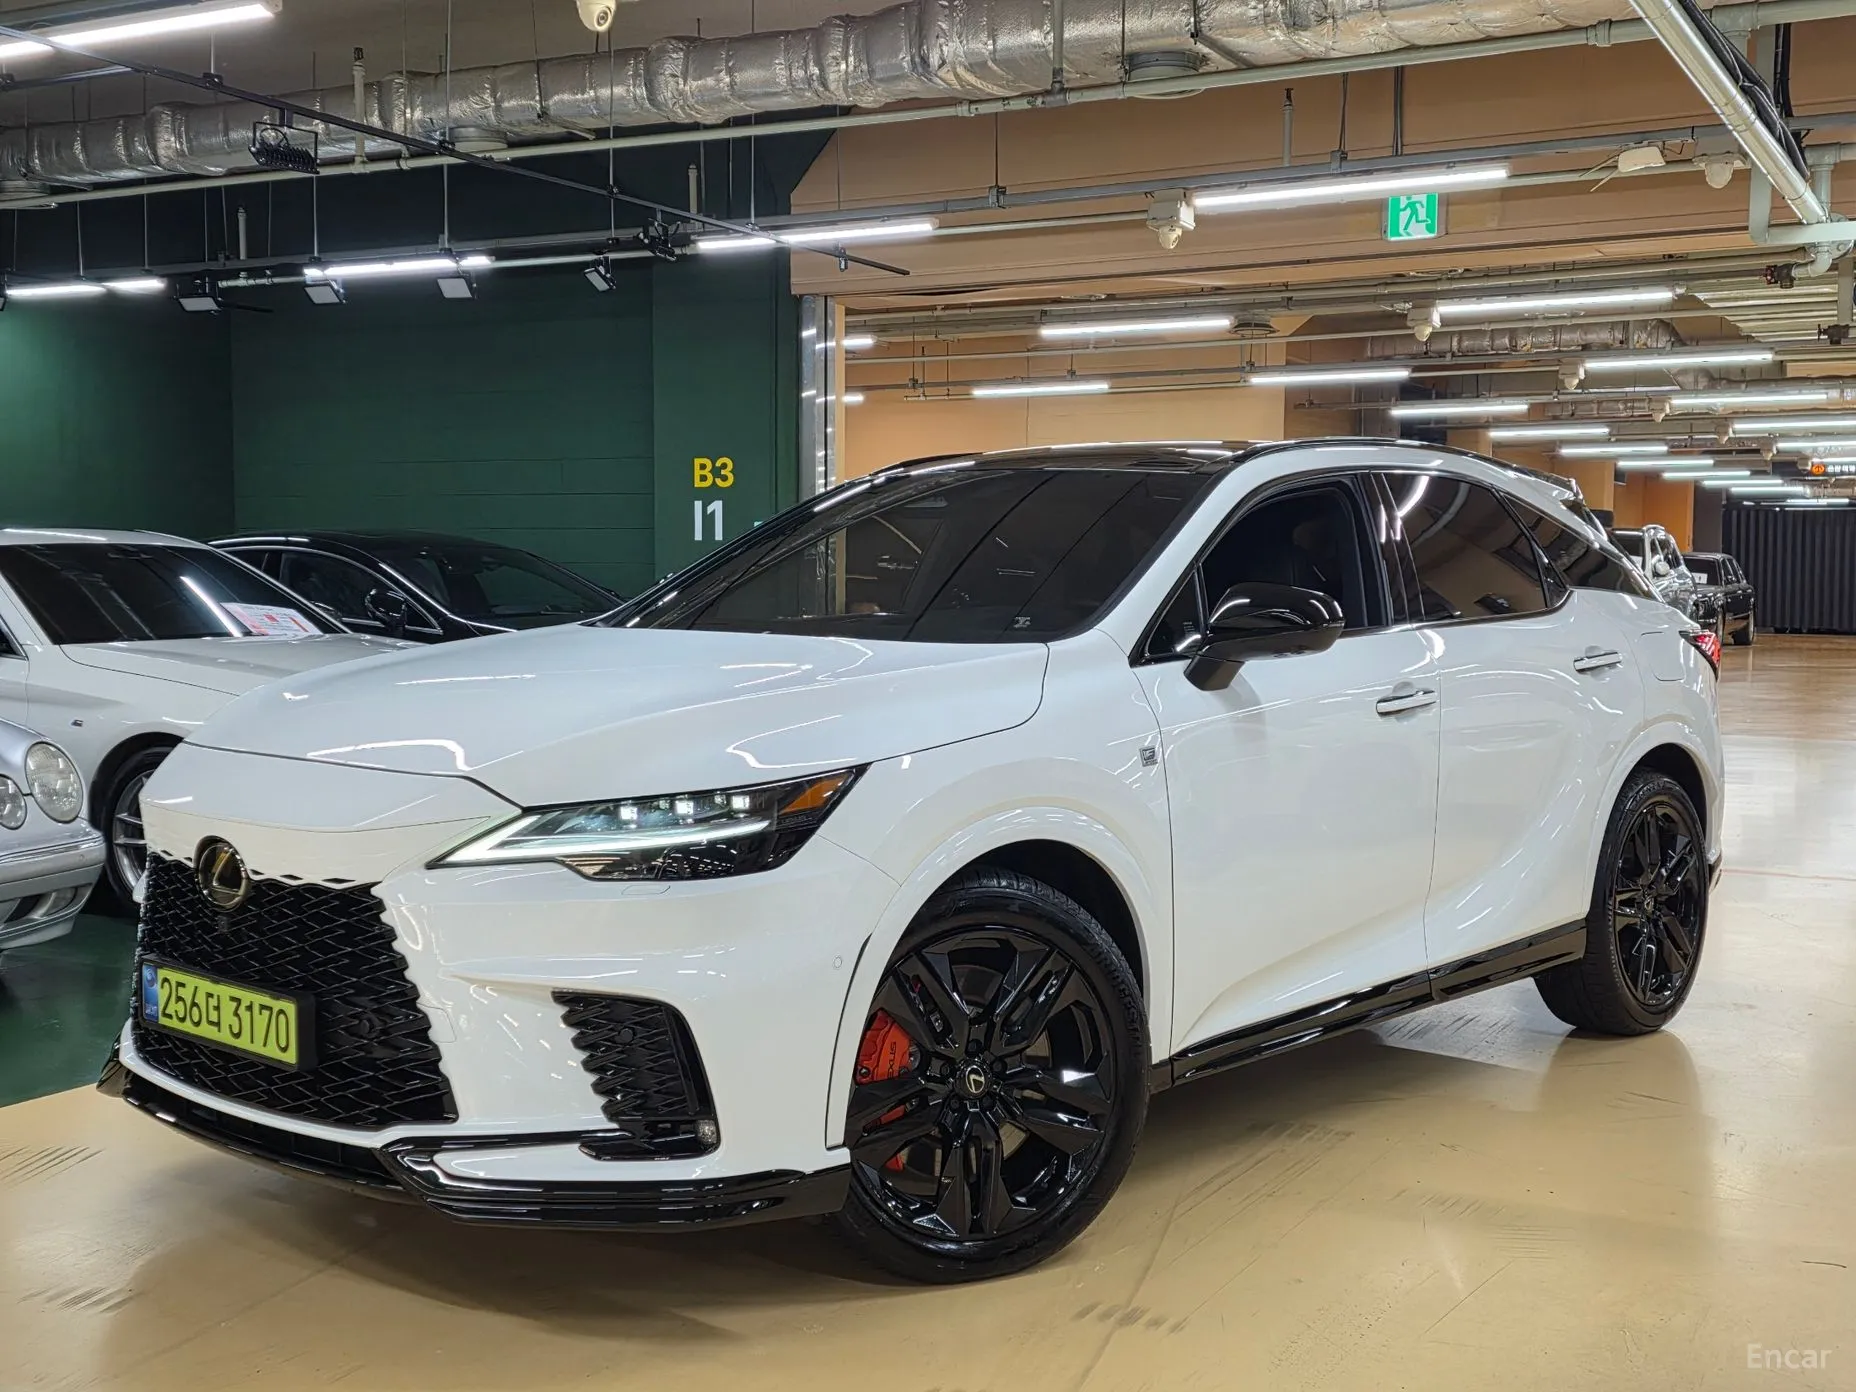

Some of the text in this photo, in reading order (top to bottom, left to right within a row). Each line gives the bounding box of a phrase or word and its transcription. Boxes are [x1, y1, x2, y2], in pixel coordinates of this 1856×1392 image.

[694, 457, 734, 488] B3
[160, 976, 289, 1054] 256더 3170
[883, 1041, 897, 1080] EXUS
